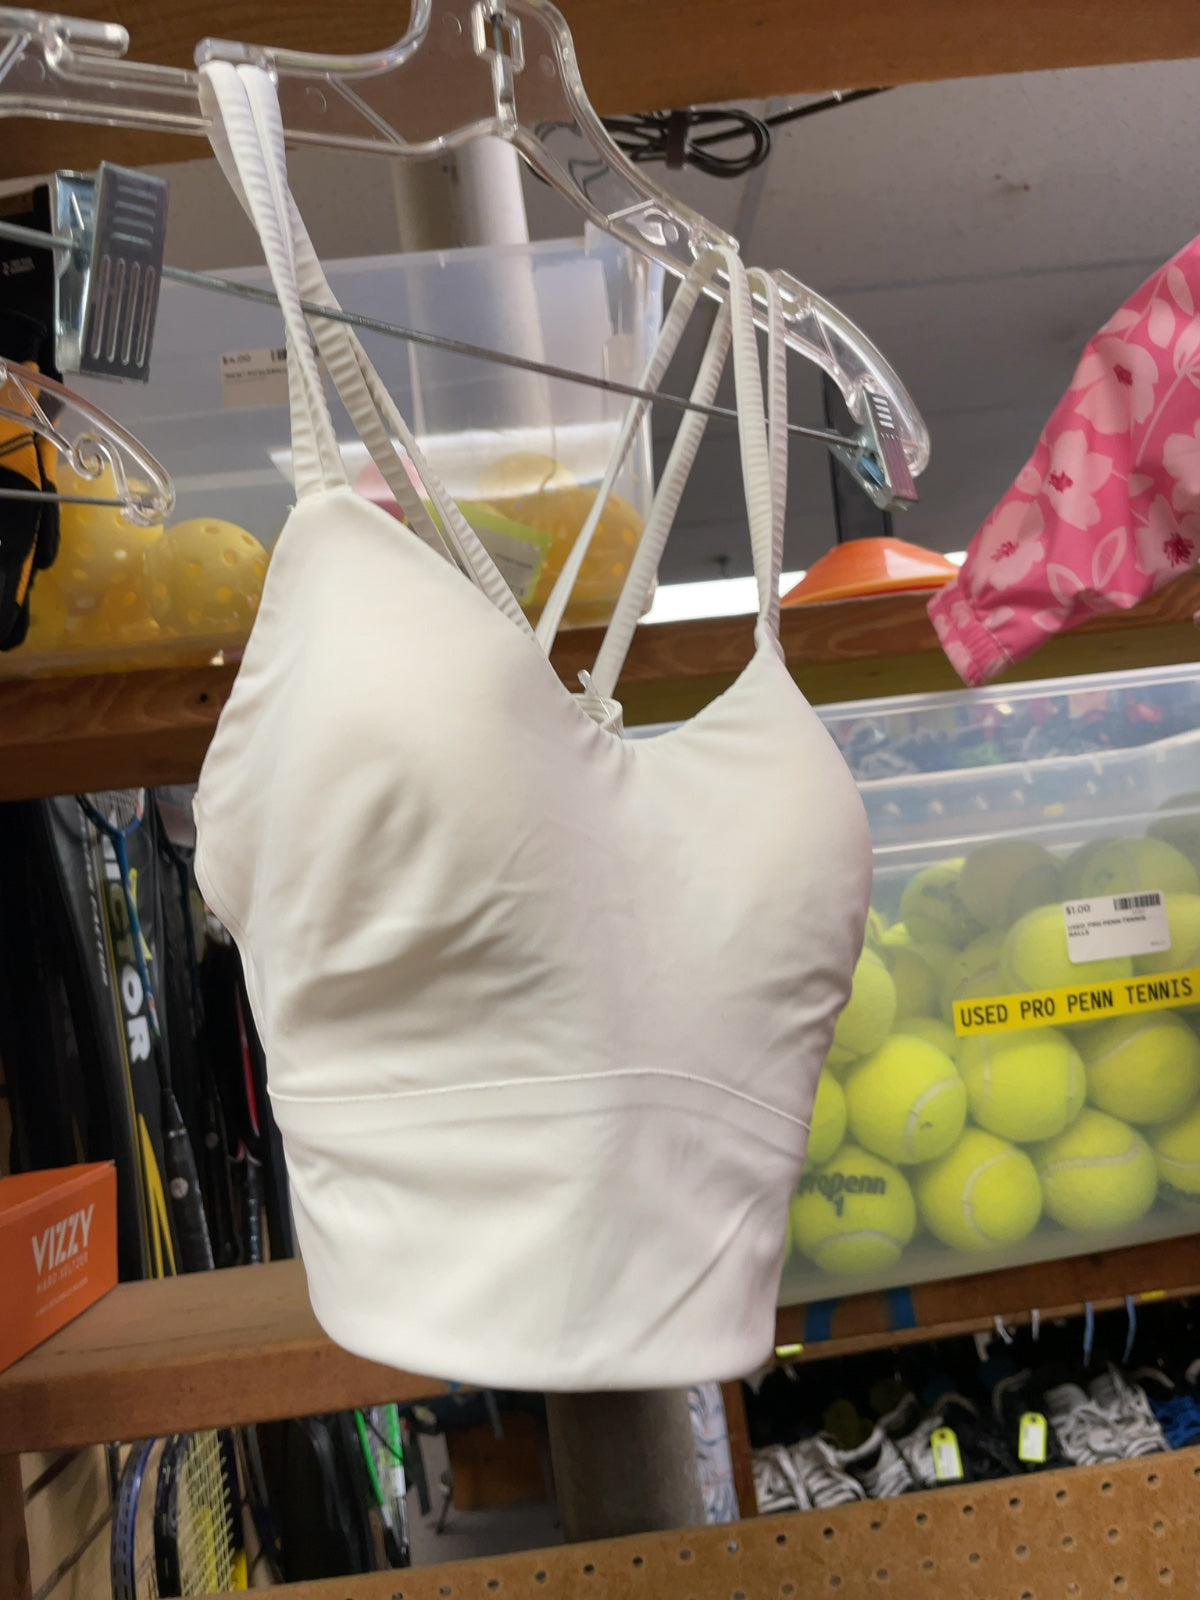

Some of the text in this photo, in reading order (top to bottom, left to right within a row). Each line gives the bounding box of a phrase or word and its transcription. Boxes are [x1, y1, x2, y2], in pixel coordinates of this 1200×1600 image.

[1065, 903, 1091, 916] $1.00
[960, 977, 1193, 1027] USED PRO PENN TENNIS
[31, 1203, 95, 1276] VIZZY
